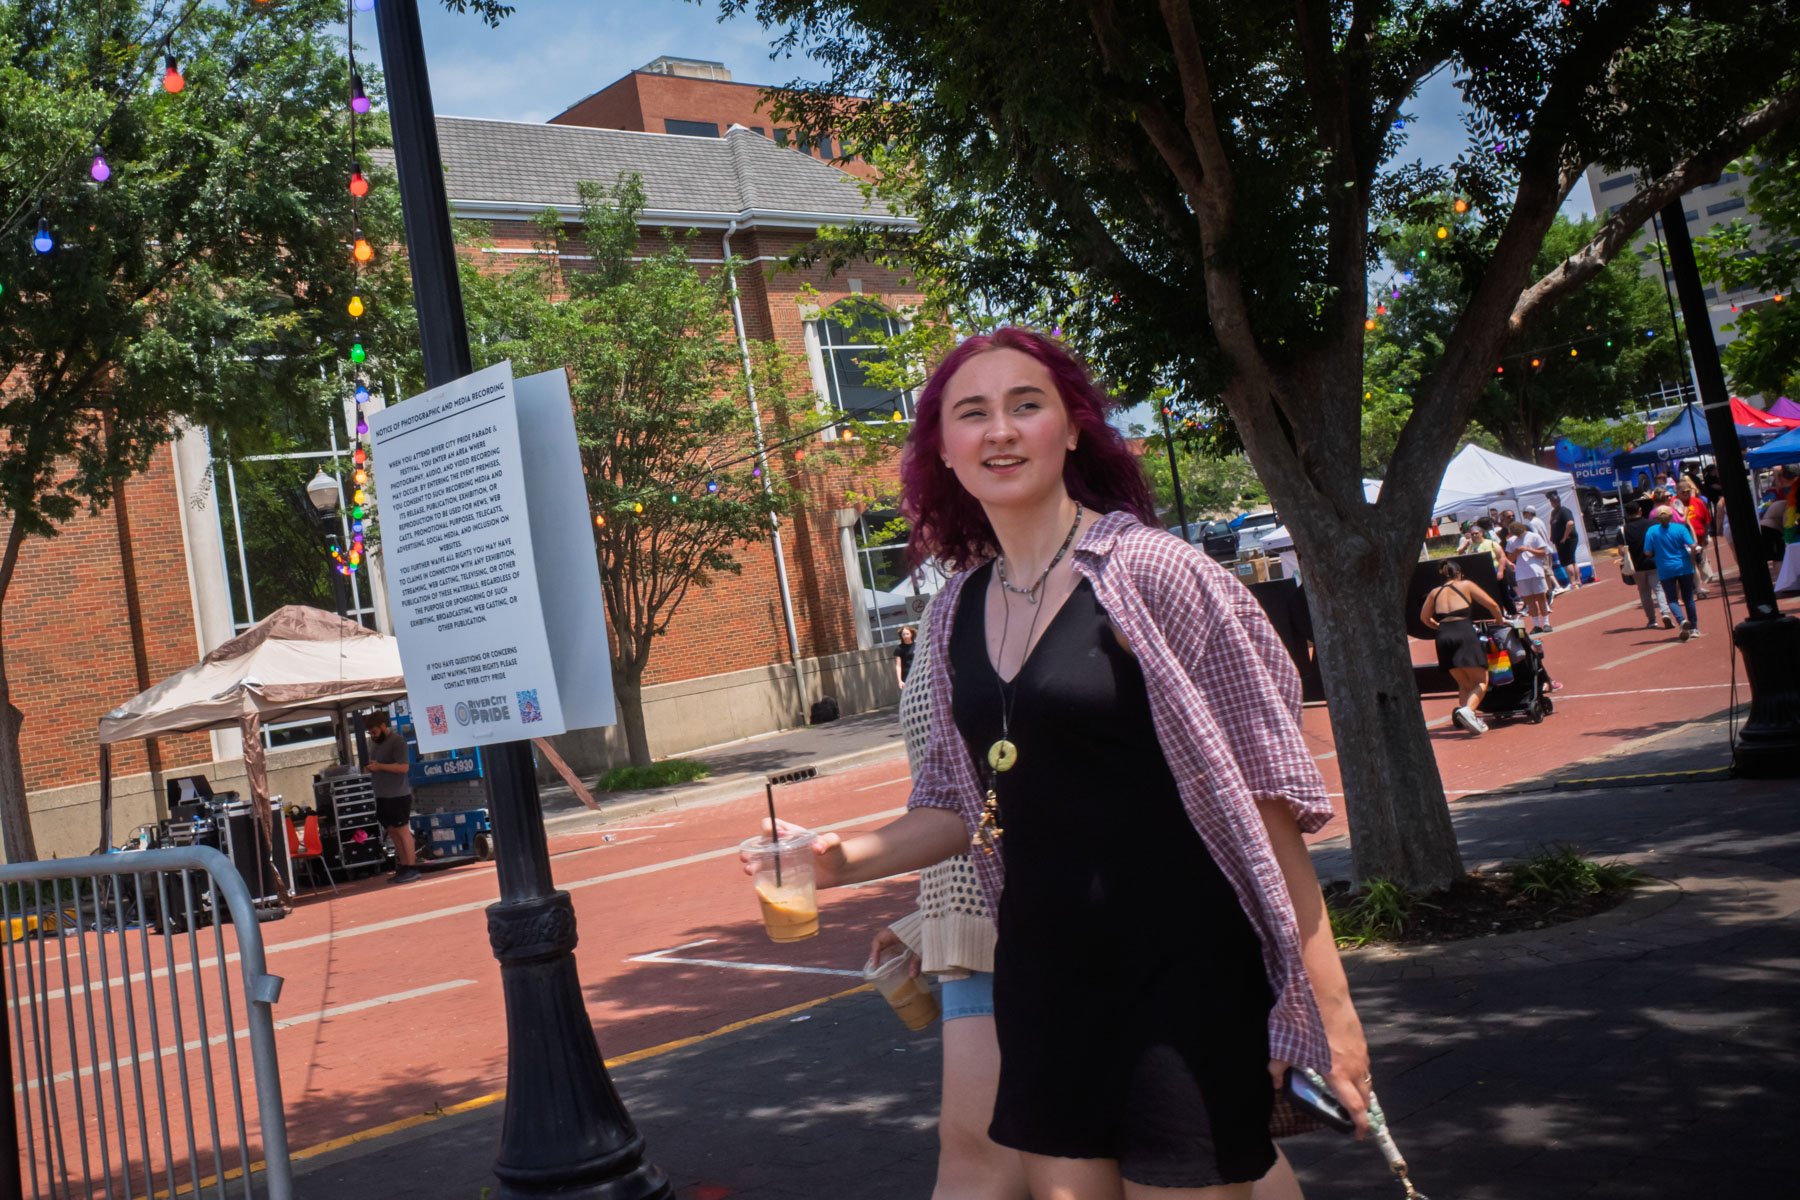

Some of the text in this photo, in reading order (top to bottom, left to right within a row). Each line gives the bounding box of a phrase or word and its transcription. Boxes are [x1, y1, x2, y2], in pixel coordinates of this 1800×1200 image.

[376, 382, 504, 437] NOTICE OF PHOTOGRAPHIC AND MEDIA RECORDING
[389, 425, 497, 468] WHEN YOU ATTEND RIVER CITY PRIDE PARADE &
[421, 459, 432, 468] YOU
[432, 454, 447, 465] ENTER
[447, 451, 455, 459] AN
[456, 447, 468, 456] AREA
[469, 440, 486, 451] WHERE
[443, 463, 454, 472] AND
[454, 457, 470, 467] VIDEO
[470, 447, 500, 462] RECORDING
[392, 492, 402, 500] MAY
[419, 483, 426, 491] BY
[427, 476, 449, 489] ENTERING
[450, 472, 459, 481] THE
[459, 467, 475, 478] EVENT
[1576, 467, 1612, 478] POLICE
[392, 469, 503, 511] YOU CONSENT TO SUCH RECORDING MEDIA AND
[399, 512, 407, 520] ITS
[489, 483, 497, 491] OR
[399, 515, 434, 531] REPRODUCTION
[442, 509, 448, 518] BE
[449, 506, 462, 515] USED
[462, 502, 472, 511] FOR
[489, 493, 501, 502] WEB
[414, 523, 448, 536] PROMOTIONAL
[426, 535, 443, 545] SOCIAL
[461, 526, 472, 535] AND
[472, 518, 500, 531] INCLUSION
[500, 515, 509, 523] ON
[400, 537, 511, 574] YOU FURTHER WAIVE ALL RIGHTS YOU MAY HAVE
[406, 574, 423, 584] CLAIMS
[429, 564, 460, 577] CONNECTION
[460, 560, 473, 568] WITH
[474, 557, 484, 566] ANY
[428, 580, 439, 588] WEB
[489, 565, 498, 573] OR
[498, 560, 516, 571] OTHER
[401, 595, 431, 607] PUBLICATION
[431, 592, 438, 600] OF
[438, 588, 453, 597] THESE
[480, 573, 511, 587] REGARDLESS
[512, 571, 520, 579] OF
[414, 586, 508, 615] THE PURPOSE OR SPONSORING OF SUCH
[474, 603, 485, 611] WEB
[509, 595, 518, 604] OR
[438, 622, 453, 632] OTHER
[431, 662, 442, 670] YOU
[442, 659, 455, 667] HAVE
[455, 654, 482, 665] QUESTIONS
[482, 652, 490, 660] OR
[490, 647, 517, 658] CONCERNS
[431, 658, 518, 681] ABOUT WAIVING THESE RIGHTS PLEASE
[444, 672, 506, 690] CONTACT RIVER CITY PRIDE
[470, 706, 510, 724] PRIDE
[443, 759, 474, 774] GS-1930
